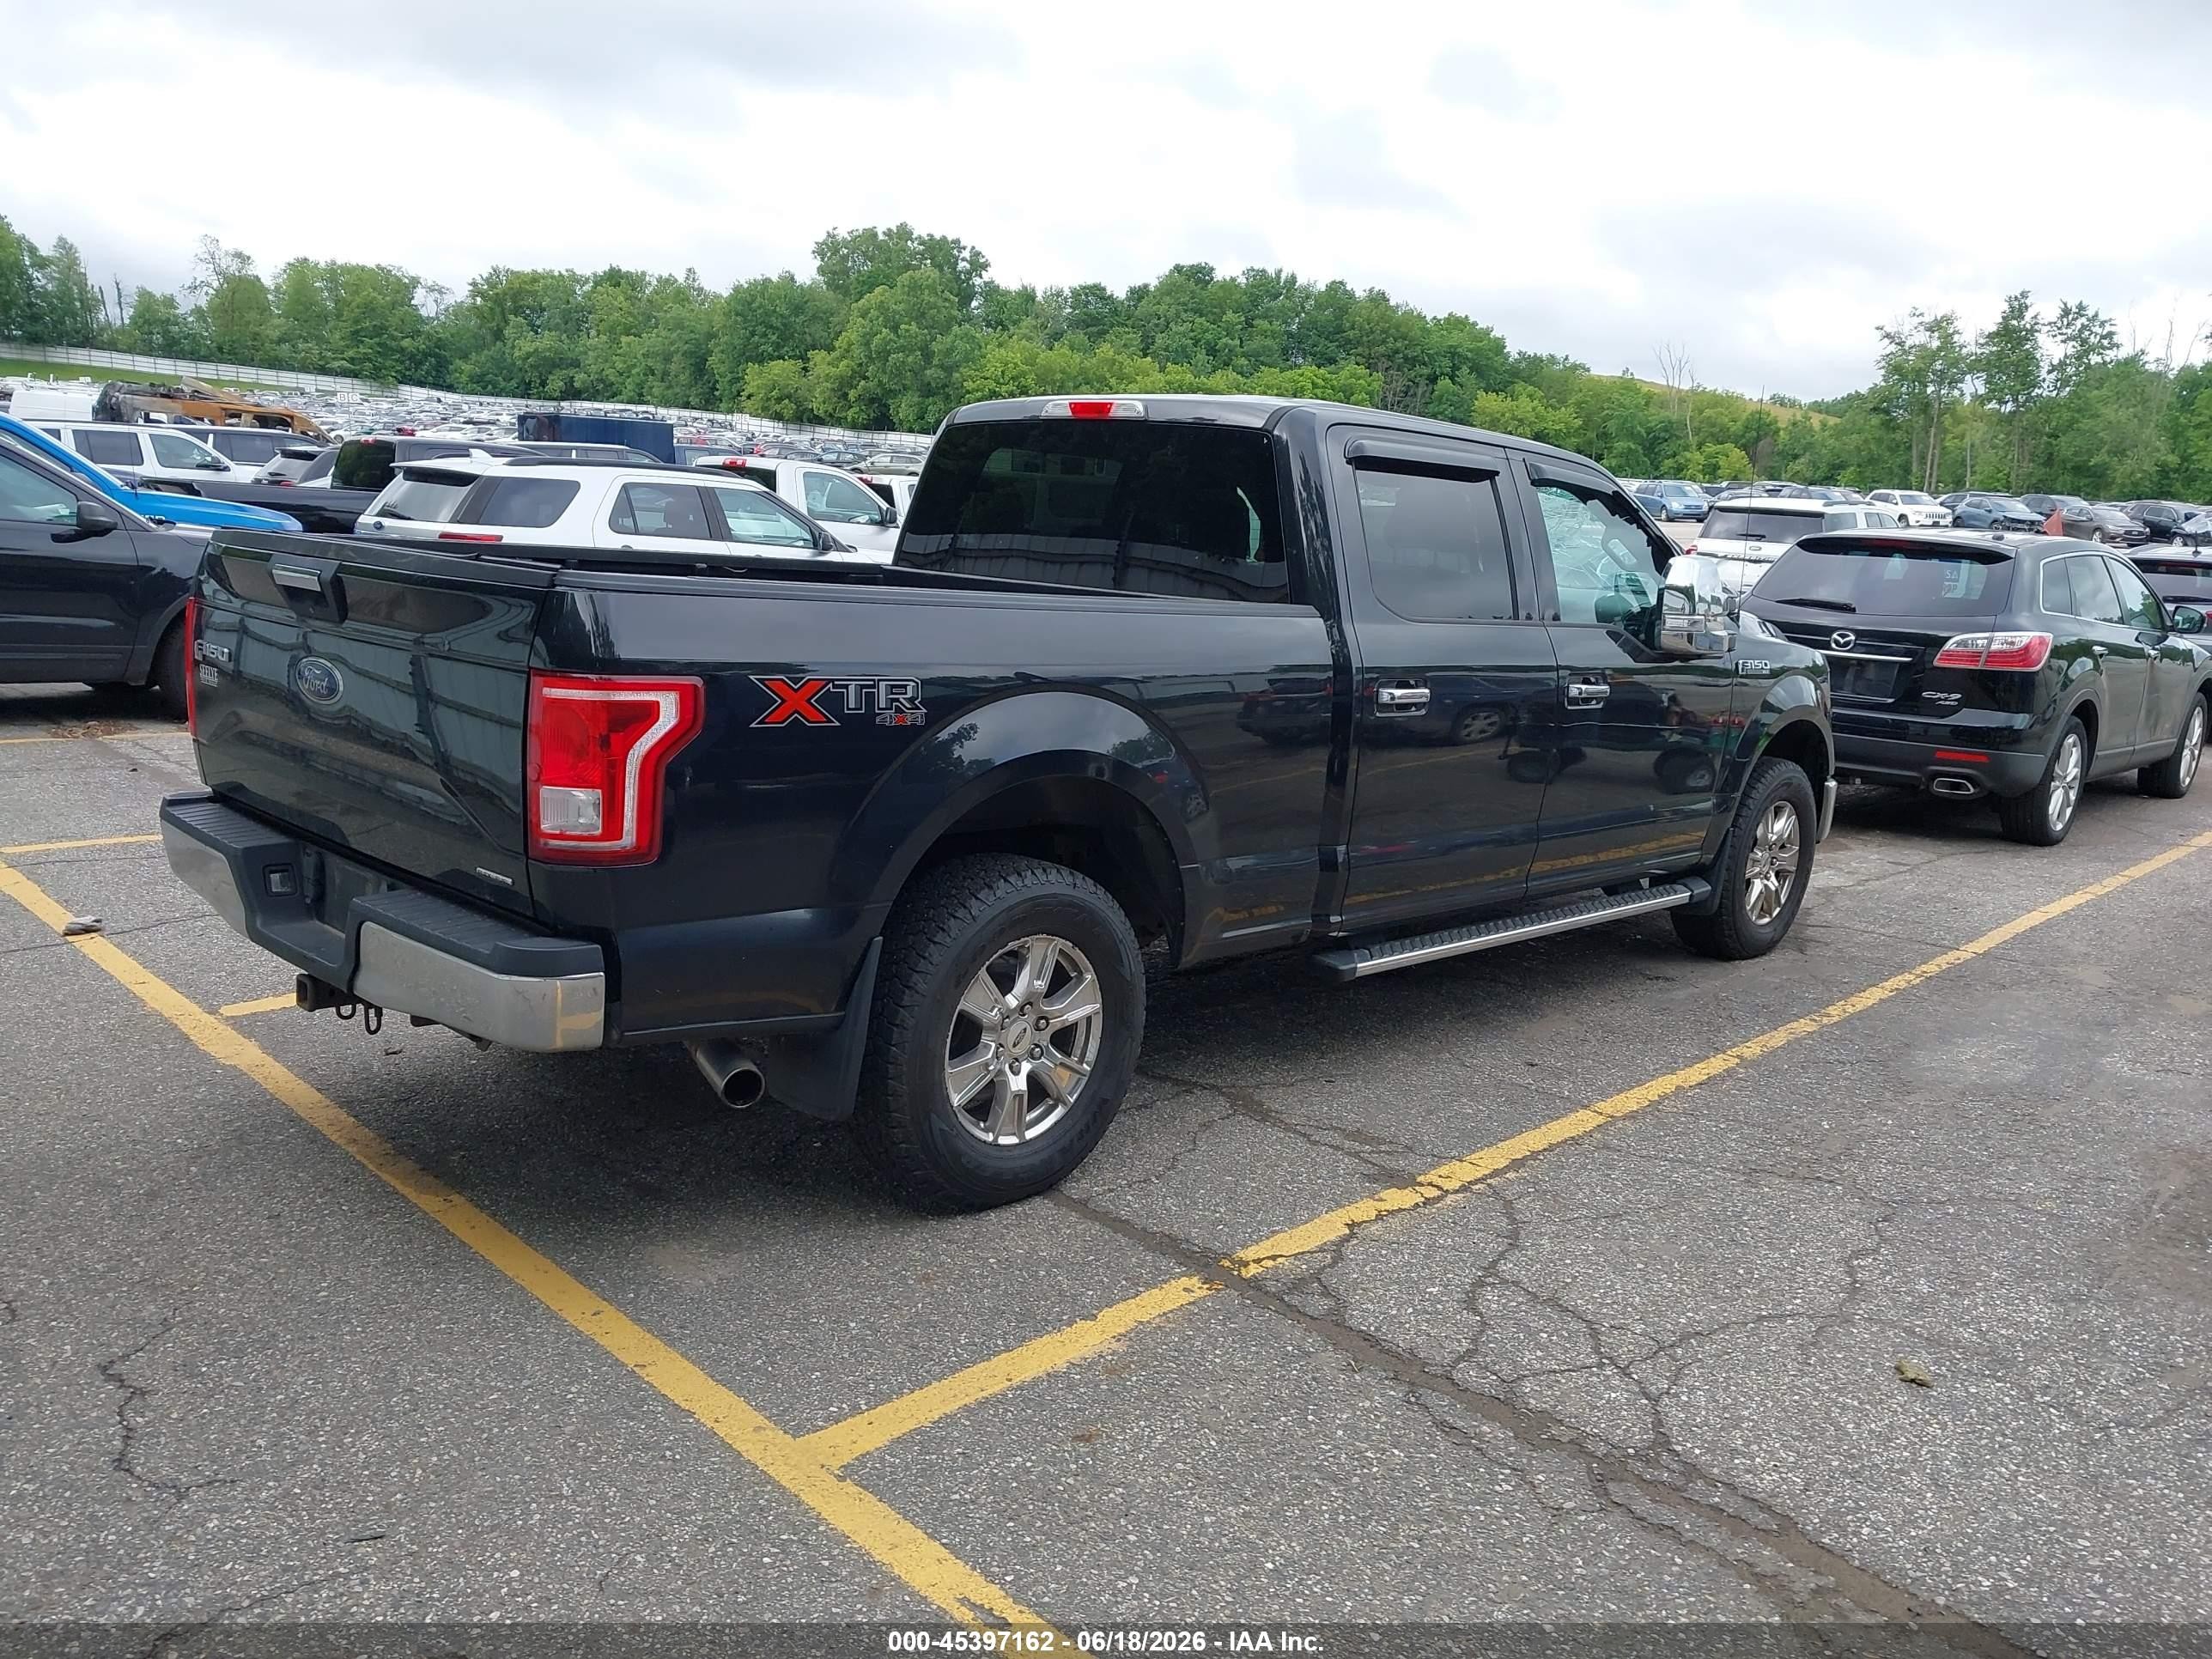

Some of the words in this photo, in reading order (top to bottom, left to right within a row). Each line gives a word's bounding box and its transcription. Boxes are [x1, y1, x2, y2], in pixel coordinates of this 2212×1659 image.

[1738, 659, 1771, 674] F150
[302, 665, 329, 694] Ford
[749, 676, 927, 727] XTR
[1922, 690, 1962, 701] CX-9
